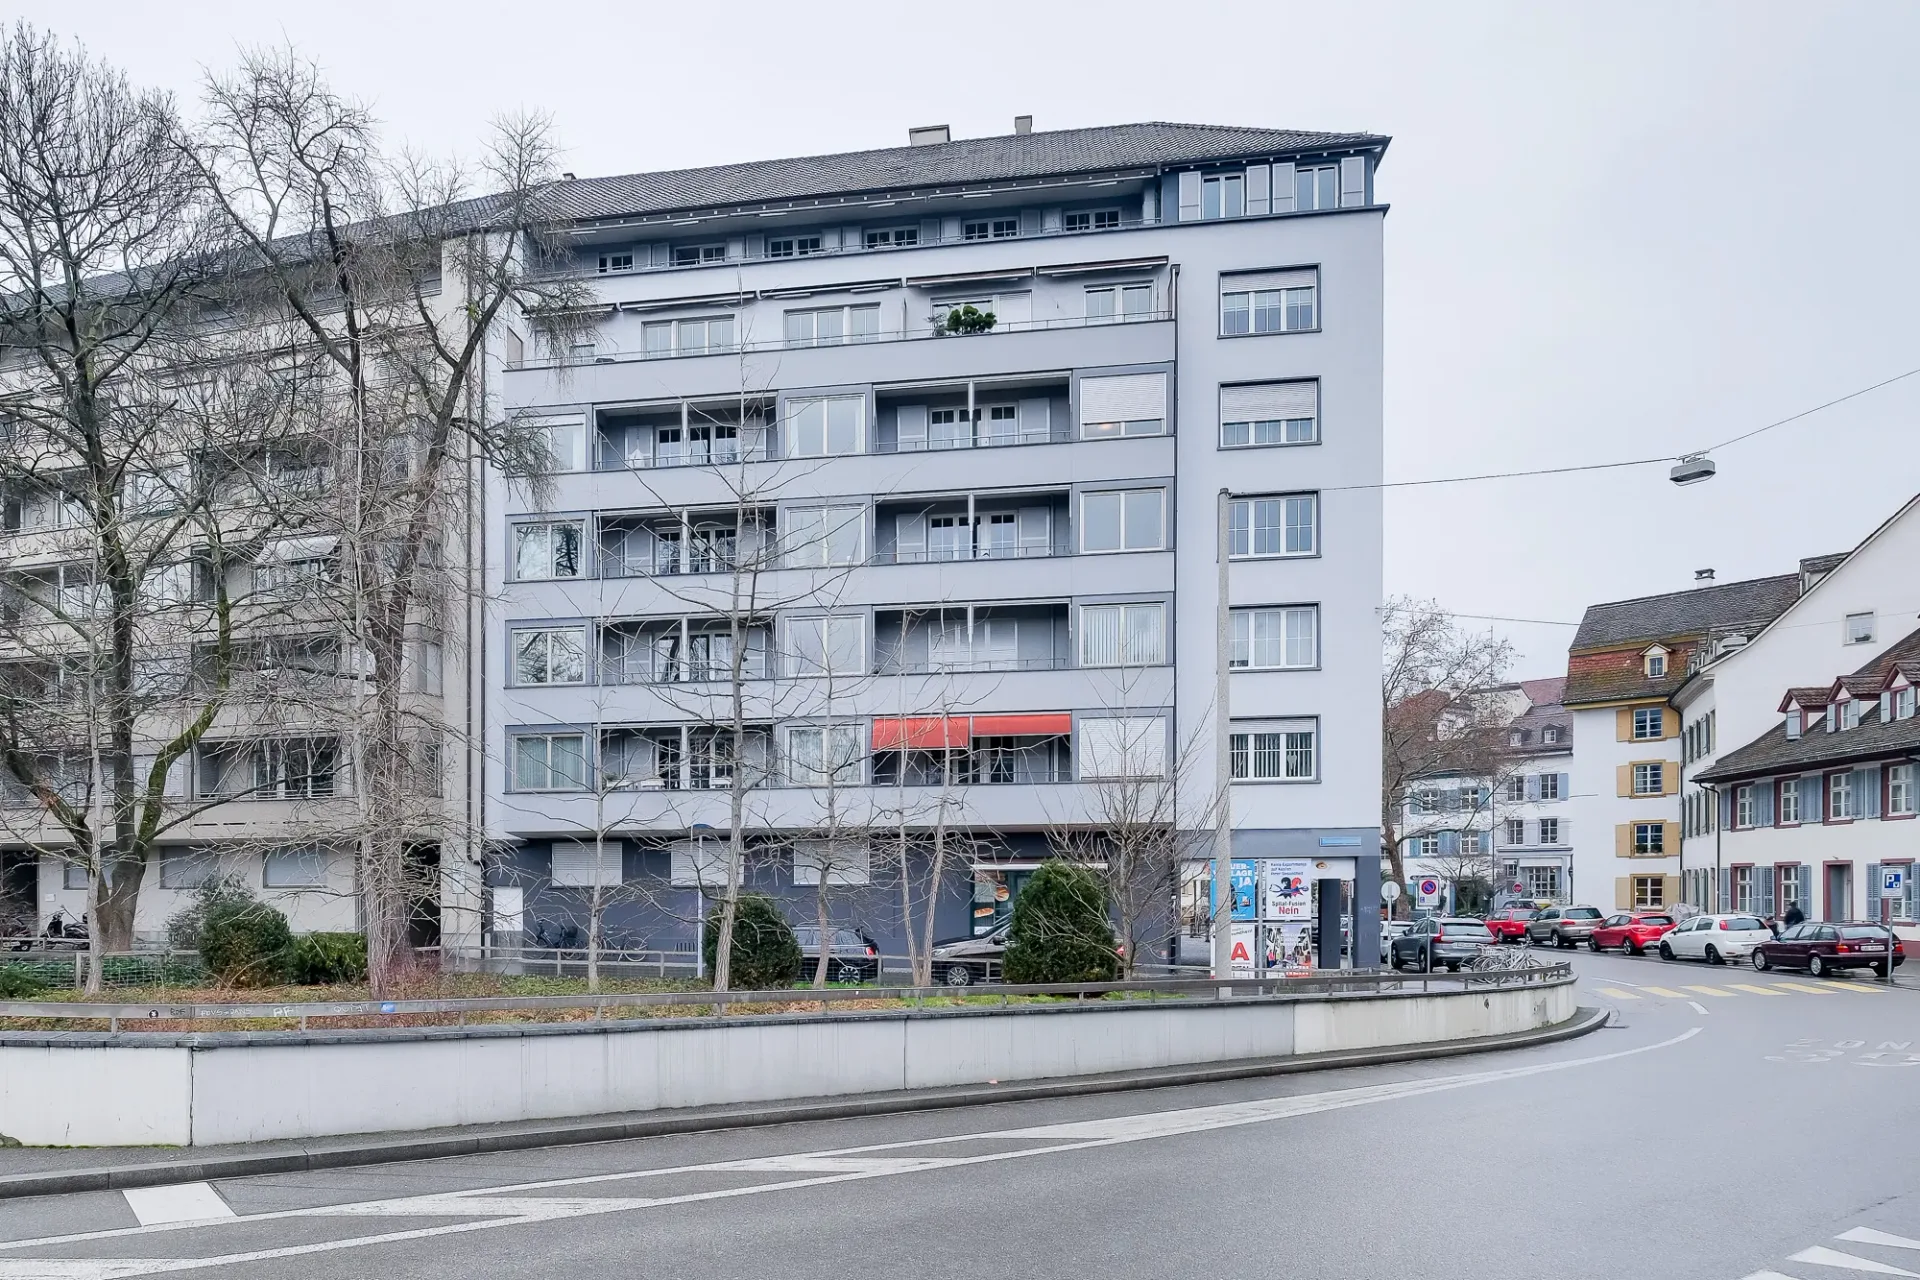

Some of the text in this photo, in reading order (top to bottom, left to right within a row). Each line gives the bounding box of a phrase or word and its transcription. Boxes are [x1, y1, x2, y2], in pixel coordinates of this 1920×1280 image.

[1238, 877, 1253, 888] JA
[1885, 874, 1895, 887] P
[1278, 906, 1299, 915] Nein
